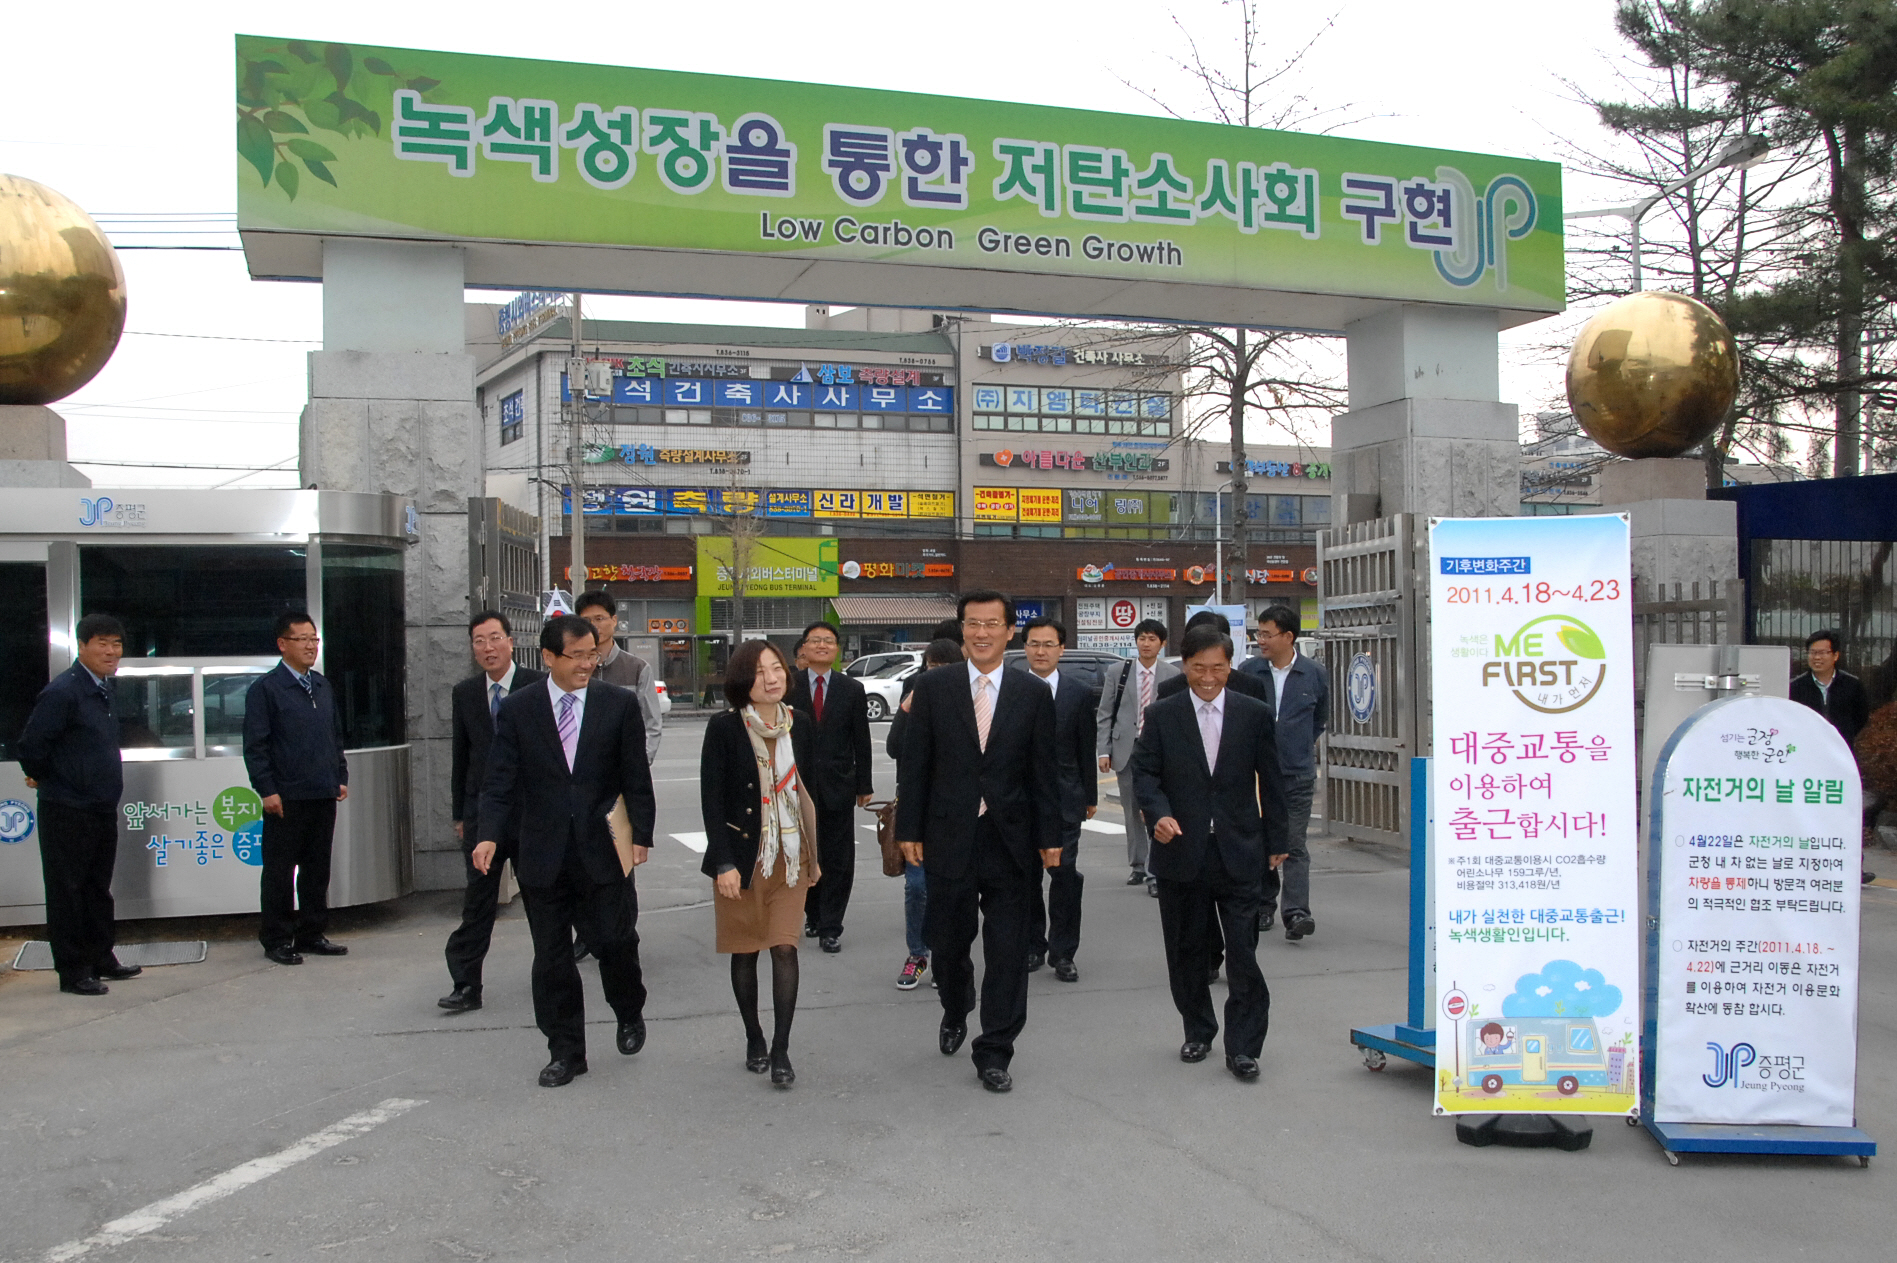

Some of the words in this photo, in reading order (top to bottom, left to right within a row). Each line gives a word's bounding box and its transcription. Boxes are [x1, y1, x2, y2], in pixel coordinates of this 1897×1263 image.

[395, 91, 794, 196] 녹색성장을
[824, 125, 973, 208] 통한
[994, 139, 1319, 238] 저탄소사회
[1343, 164, 1457, 249] 구현
[762, 213, 822, 241] Low
[834, 218, 953, 249] Carbon
[978, 228, 1070, 257] Green
[1082, 236, 1182, 265] Growth
[817, 364, 854, 384] 삼보
[568, 380, 943, 410] 석건축사사무소
[619, 443, 657, 465] 정원
[1021, 450, 1085, 470] 아름다운
[1092, 451, 1153, 471] 산부인과
[116, 504, 146, 520] 증평군
[591, 564, 618, 581] 고향
[864, 563, 925, 578] 평화마켓
[1446, 559, 1525, 573] 기후변화주간
[1447, 579, 1620, 605] 2011.4.18~4.23
[1115, 605, 1134, 624] 땅
[1460, 635, 1488, 645] 녹색은
[1494, 633, 1543, 657] ME
[1451, 647, 1488, 657] 생활이다
[1482, 660, 1578, 687] FIRST
[1537, 693, 1563, 705] 내가
[1568, 676, 1592, 699] 먼저
[1720, 733, 1745, 743] 섬기는
[1449, 731, 1612, 765] 대중교통을
[1735, 750, 1759, 760] 행복한
[1450, 773, 1551, 800] 이용하여
[1683, 777, 1764, 803] 자전거의
[1775, 778, 1795, 803] 날
[1803, 778, 1844, 804] 알림
[123, 800, 208, 830] 앞서가는
[221, 795, 257, 825] 복지
[1449, 807, 1606, 840] 출근합시다!
[146, 831, 225, 867] 살기좋은
[1689, 835, 1743, 848] 4월22일은
[1749, 836, 1793, 849] 자전거의
[1799, 836, 1846, 850] 날입니다.
[1485, 855, 1551, 865] 대중교통이용시
[1555, 854, 1606, 865] CO2흡수량
[1689, 856, 1710, 869] 군청
[1715, 856, 1725, 869] 내
[1731, 857, 1741, 868] 차
[1745, 857, 1767, 870] 없는
[1772, 857, 1793, 870] 날로
[1799, 857, 1843, 871] 지정하여
[1457, 868, 1503, 878] 어린소나무
[1457, 880, 1495, 890] 비용절약
[1498, 879, 1560, 890] 313,418원/년
[1689, 877, 1721, 890] 차량을
[1725, 877, 1768, 890] 통제하니
[1774, 878, 1805, 891] 방문객
[1810, 879, 1843, 892] 여러분
[1688, 897, 1698, 910] 의
[1703, 898, 1746, 911] 적극적인
[1750, 898, 1771, 911] 협조
[1776, 899, 1846, 914] 부탁드립니다.
[1449, 909, 1476, 924] 내가
[1482, 909, 1525, 924] 실천한
[1530, 908, 1625, 924] 대중교통출근!
[1449, 927, 1570, 943] 녹색생활인입니다.
[1687, 939, 1731, 952] 자전거의
[1686, 961, 1725, 973] 4.22)에
[1730, 961, 1763, 974] 근거리
[1768, 962, 1801, 976] 이동은
[1806, 963, 1839, 976] 자전거
[1686, 981, 1696, 994] 를
[1701, 981, 1746, 995] 이용하여
[1752, 982, 1786, 995] 자전거
[1792, 983, 1840, 997] 이용문화
[1685, 1002, 1717, 1015] 확산에
[1722, 1002, 1744, 1016] 동참
[1749, 1003, 1785, 1016] 합시다.
[1759, 1056, 1805, 1080] 증평군
[1740, 1080, 1767, 1091] Jeung
[1770, 1081, 1805, 1092] Pyeong
